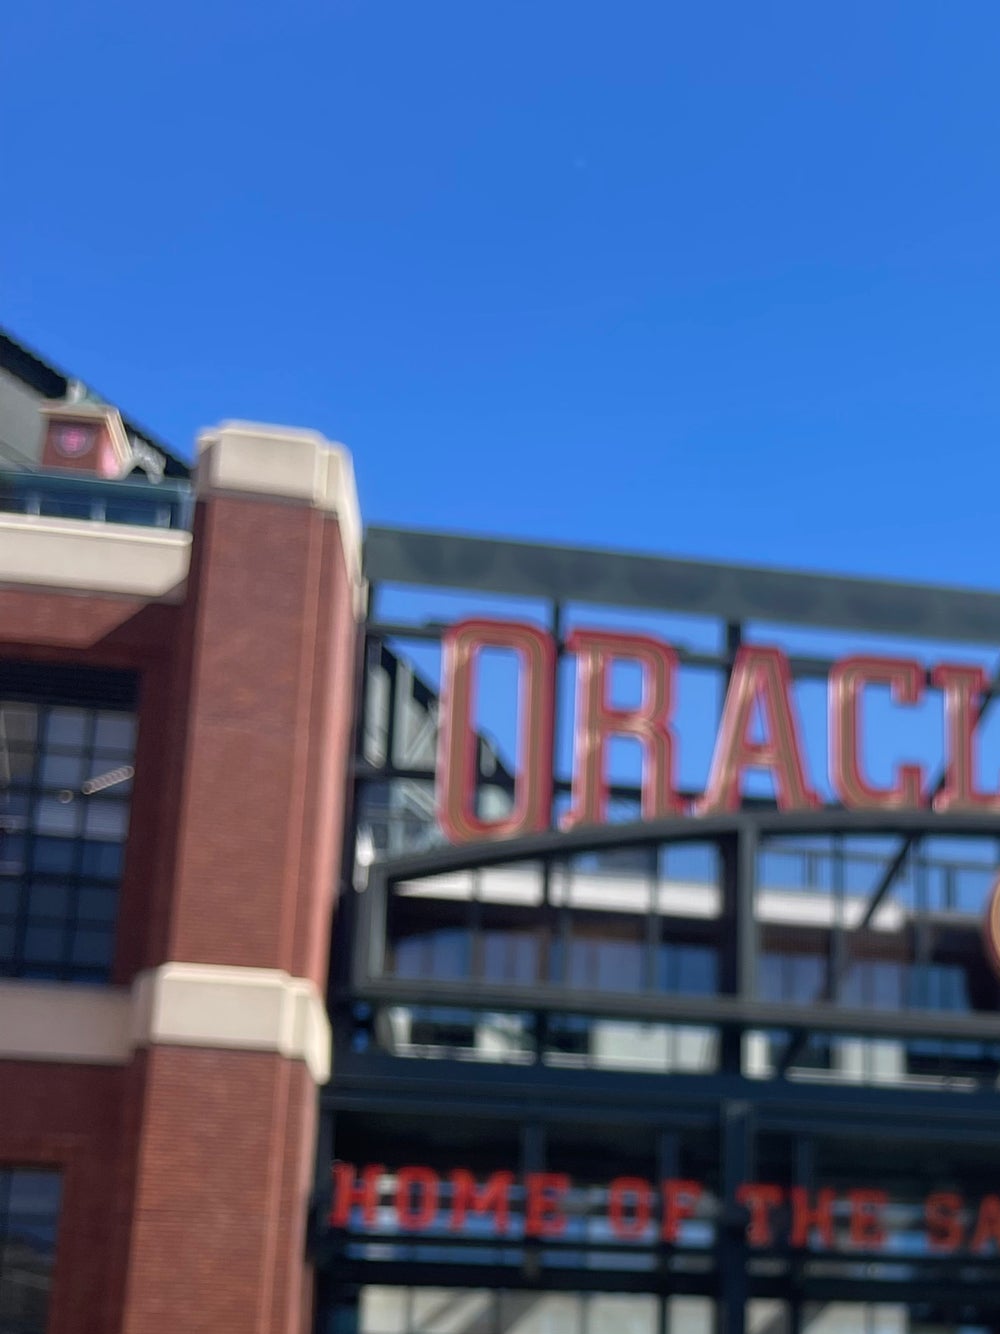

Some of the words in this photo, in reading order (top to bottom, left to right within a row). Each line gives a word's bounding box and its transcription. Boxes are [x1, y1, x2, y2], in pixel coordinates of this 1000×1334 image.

[330, 1161, 572, 1237] HOME
[606, 1176, 704, 1243] OF
[736, 1183, 888, 1248] THE
